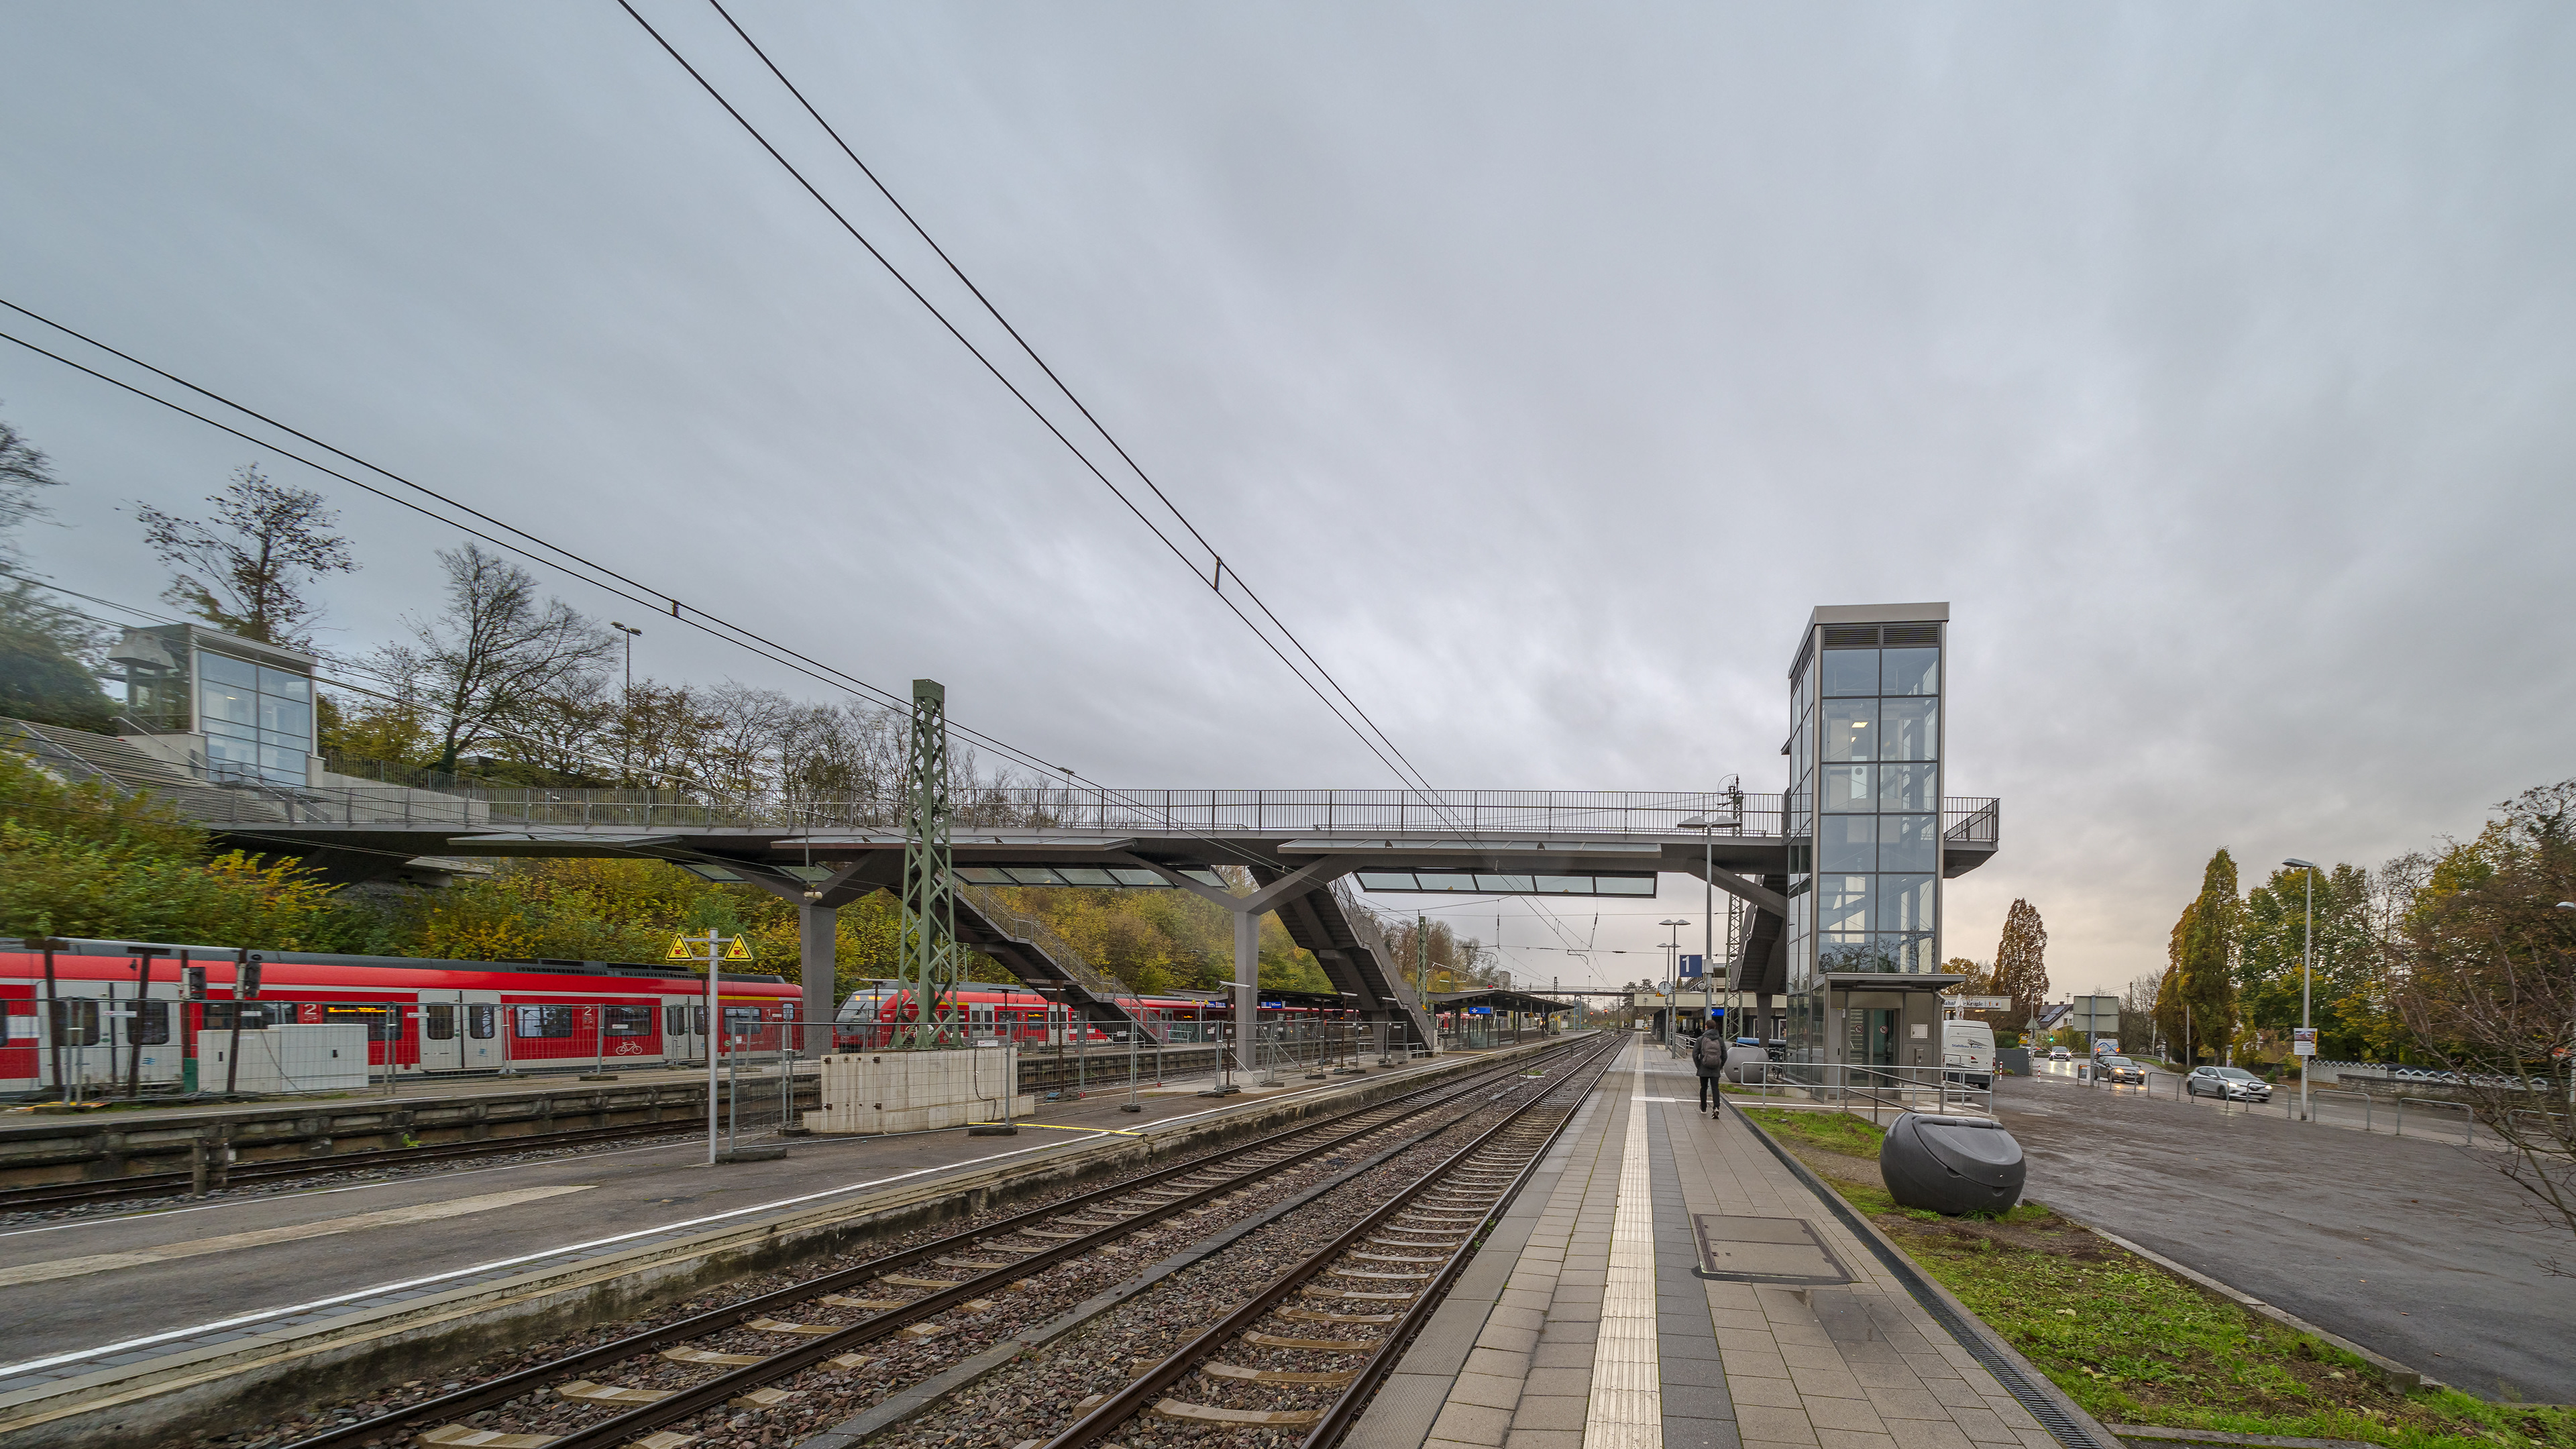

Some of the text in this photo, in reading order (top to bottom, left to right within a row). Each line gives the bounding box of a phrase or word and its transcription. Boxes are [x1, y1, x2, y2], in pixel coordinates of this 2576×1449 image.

[1682, 955, 1690, 973] 1
[303, 1004, 317, 1015] 2
[584, 1006, 592, 1016] 2
[766, 1008, 771, 1016] 1
